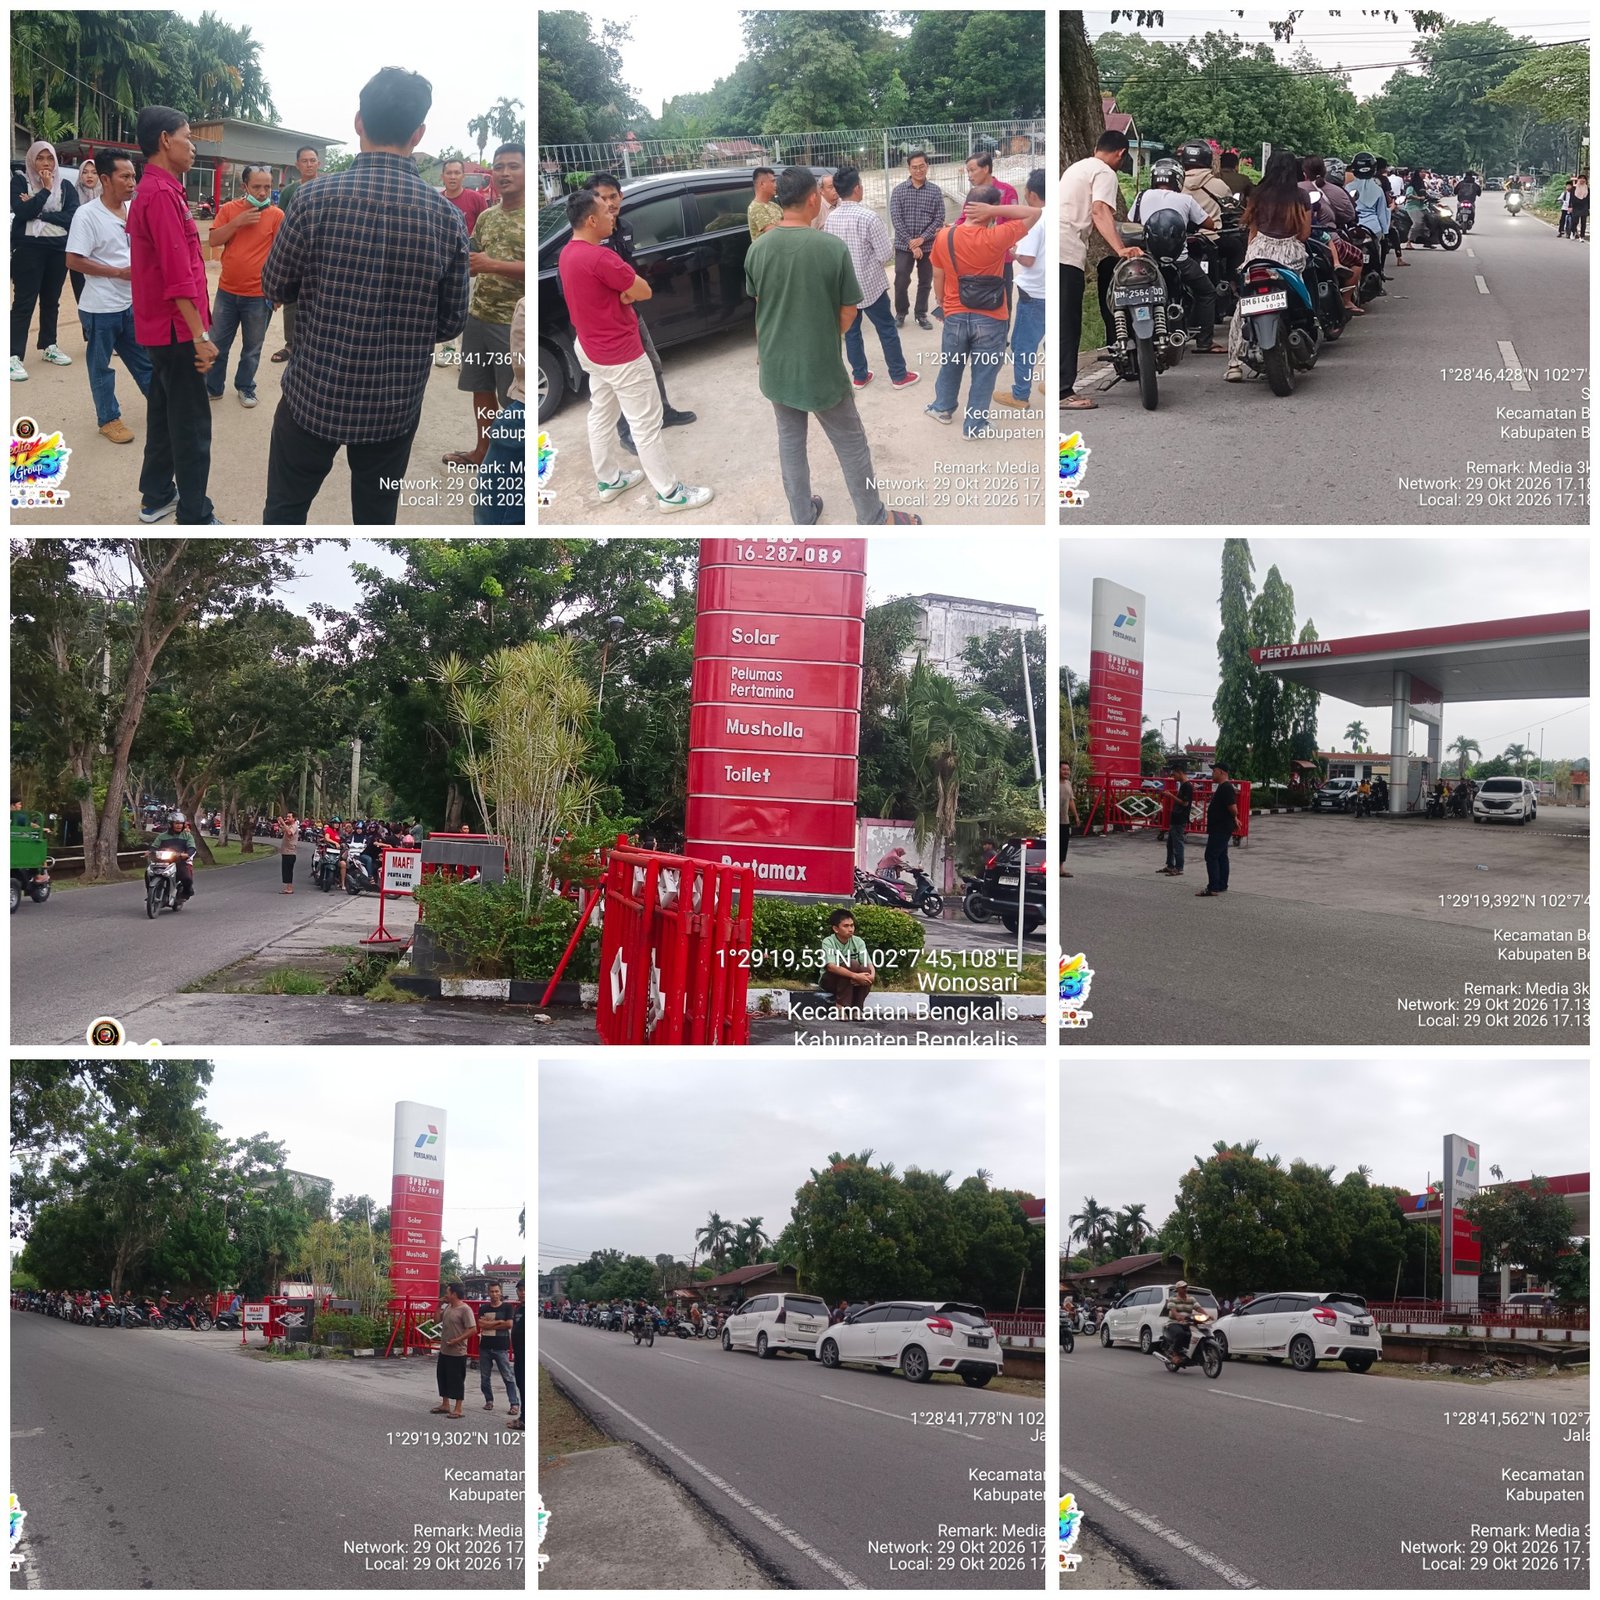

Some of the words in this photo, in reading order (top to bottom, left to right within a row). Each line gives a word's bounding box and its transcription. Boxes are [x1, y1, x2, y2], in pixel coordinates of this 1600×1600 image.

[731, 627, 780, 645] Solar
[1259, 642, 1332, 659] PERTAMINA
[731, 666, 783, 682] Pelumas
[730, 683, 794, 699] Pertamina
[1106, 693, 1122, 703] Solar
[726, 718, 804, 738] Musholla
[1105, 727, 1129, 737] Musholla
[1105, 744, 1120, 753] Toilet
[724, 765, 771, 783] Toilet
[408, 1216, 422, 1224] Solar
[406, 1250, 428, 1258] Musholla
[405, 1267, 419, 1275] Toilet
